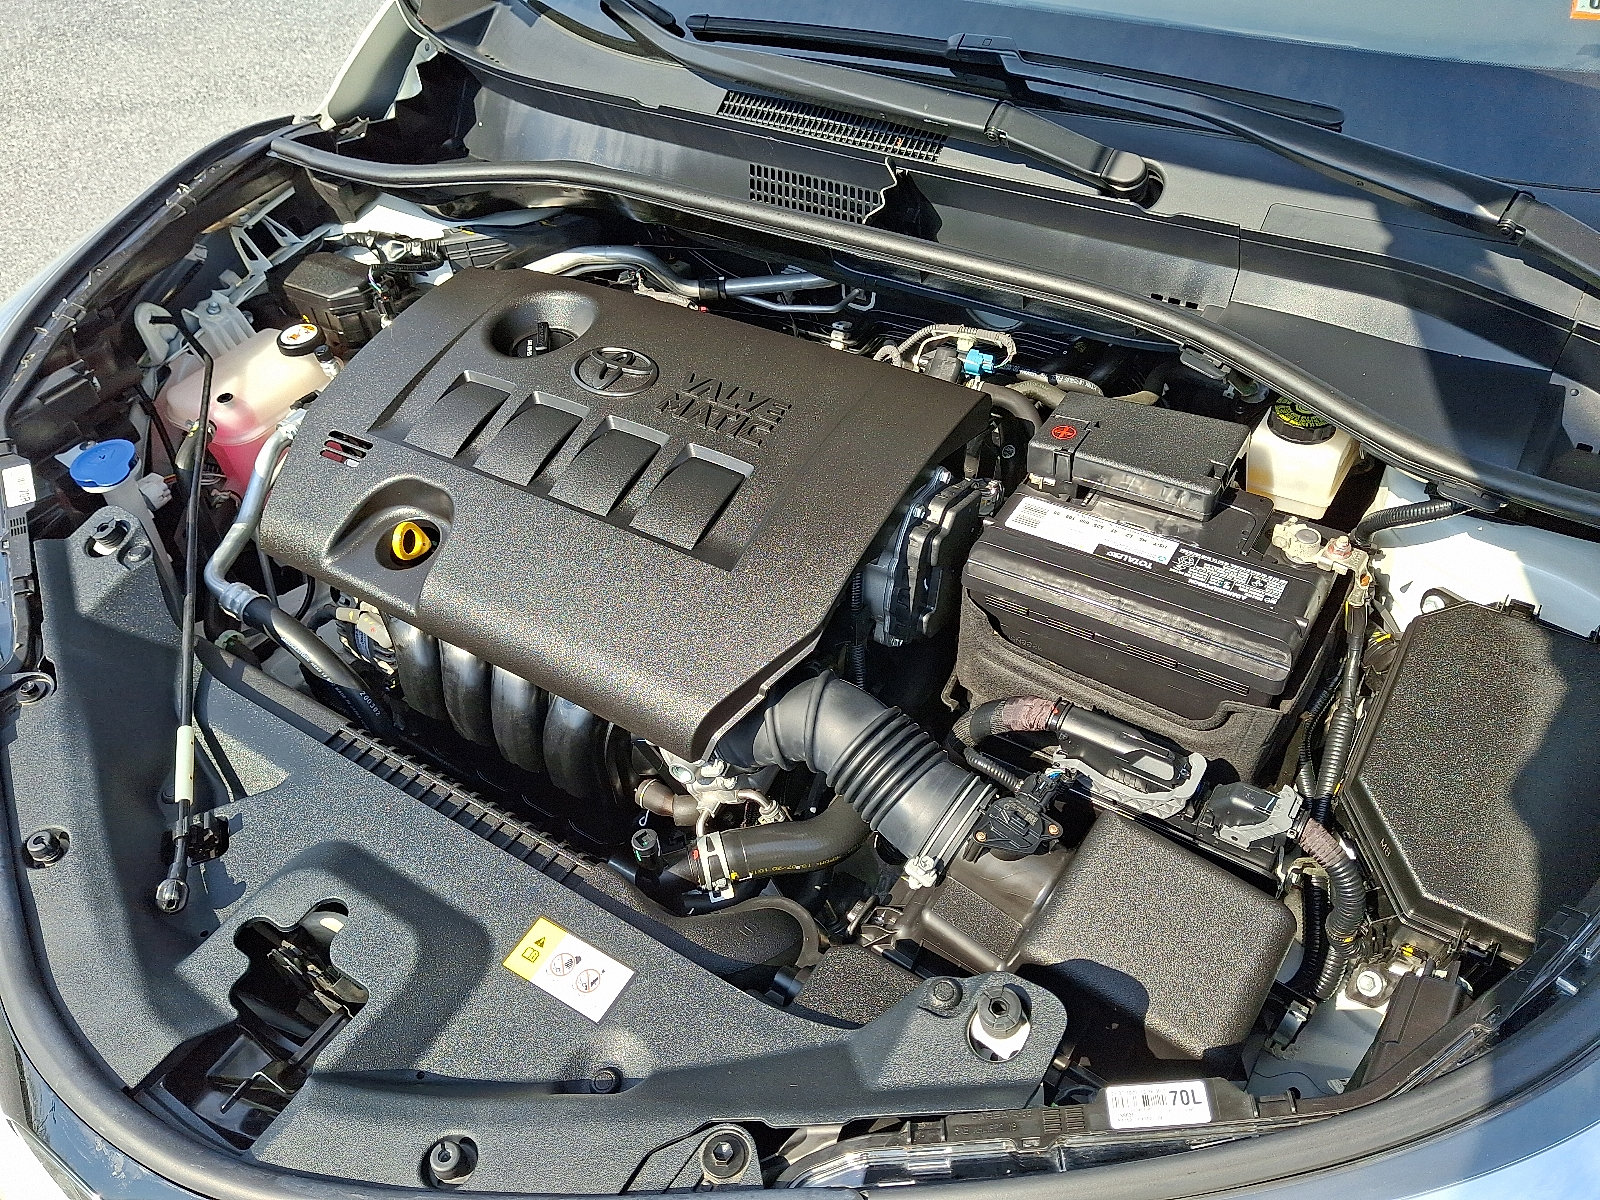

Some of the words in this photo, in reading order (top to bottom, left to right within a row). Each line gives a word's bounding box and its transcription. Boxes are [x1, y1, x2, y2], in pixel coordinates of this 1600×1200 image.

[654, 392, 775, 448] MATIC
[683, 372, 792, 425] VALVE
[1168, 1089, 1202, 1106] 70L
